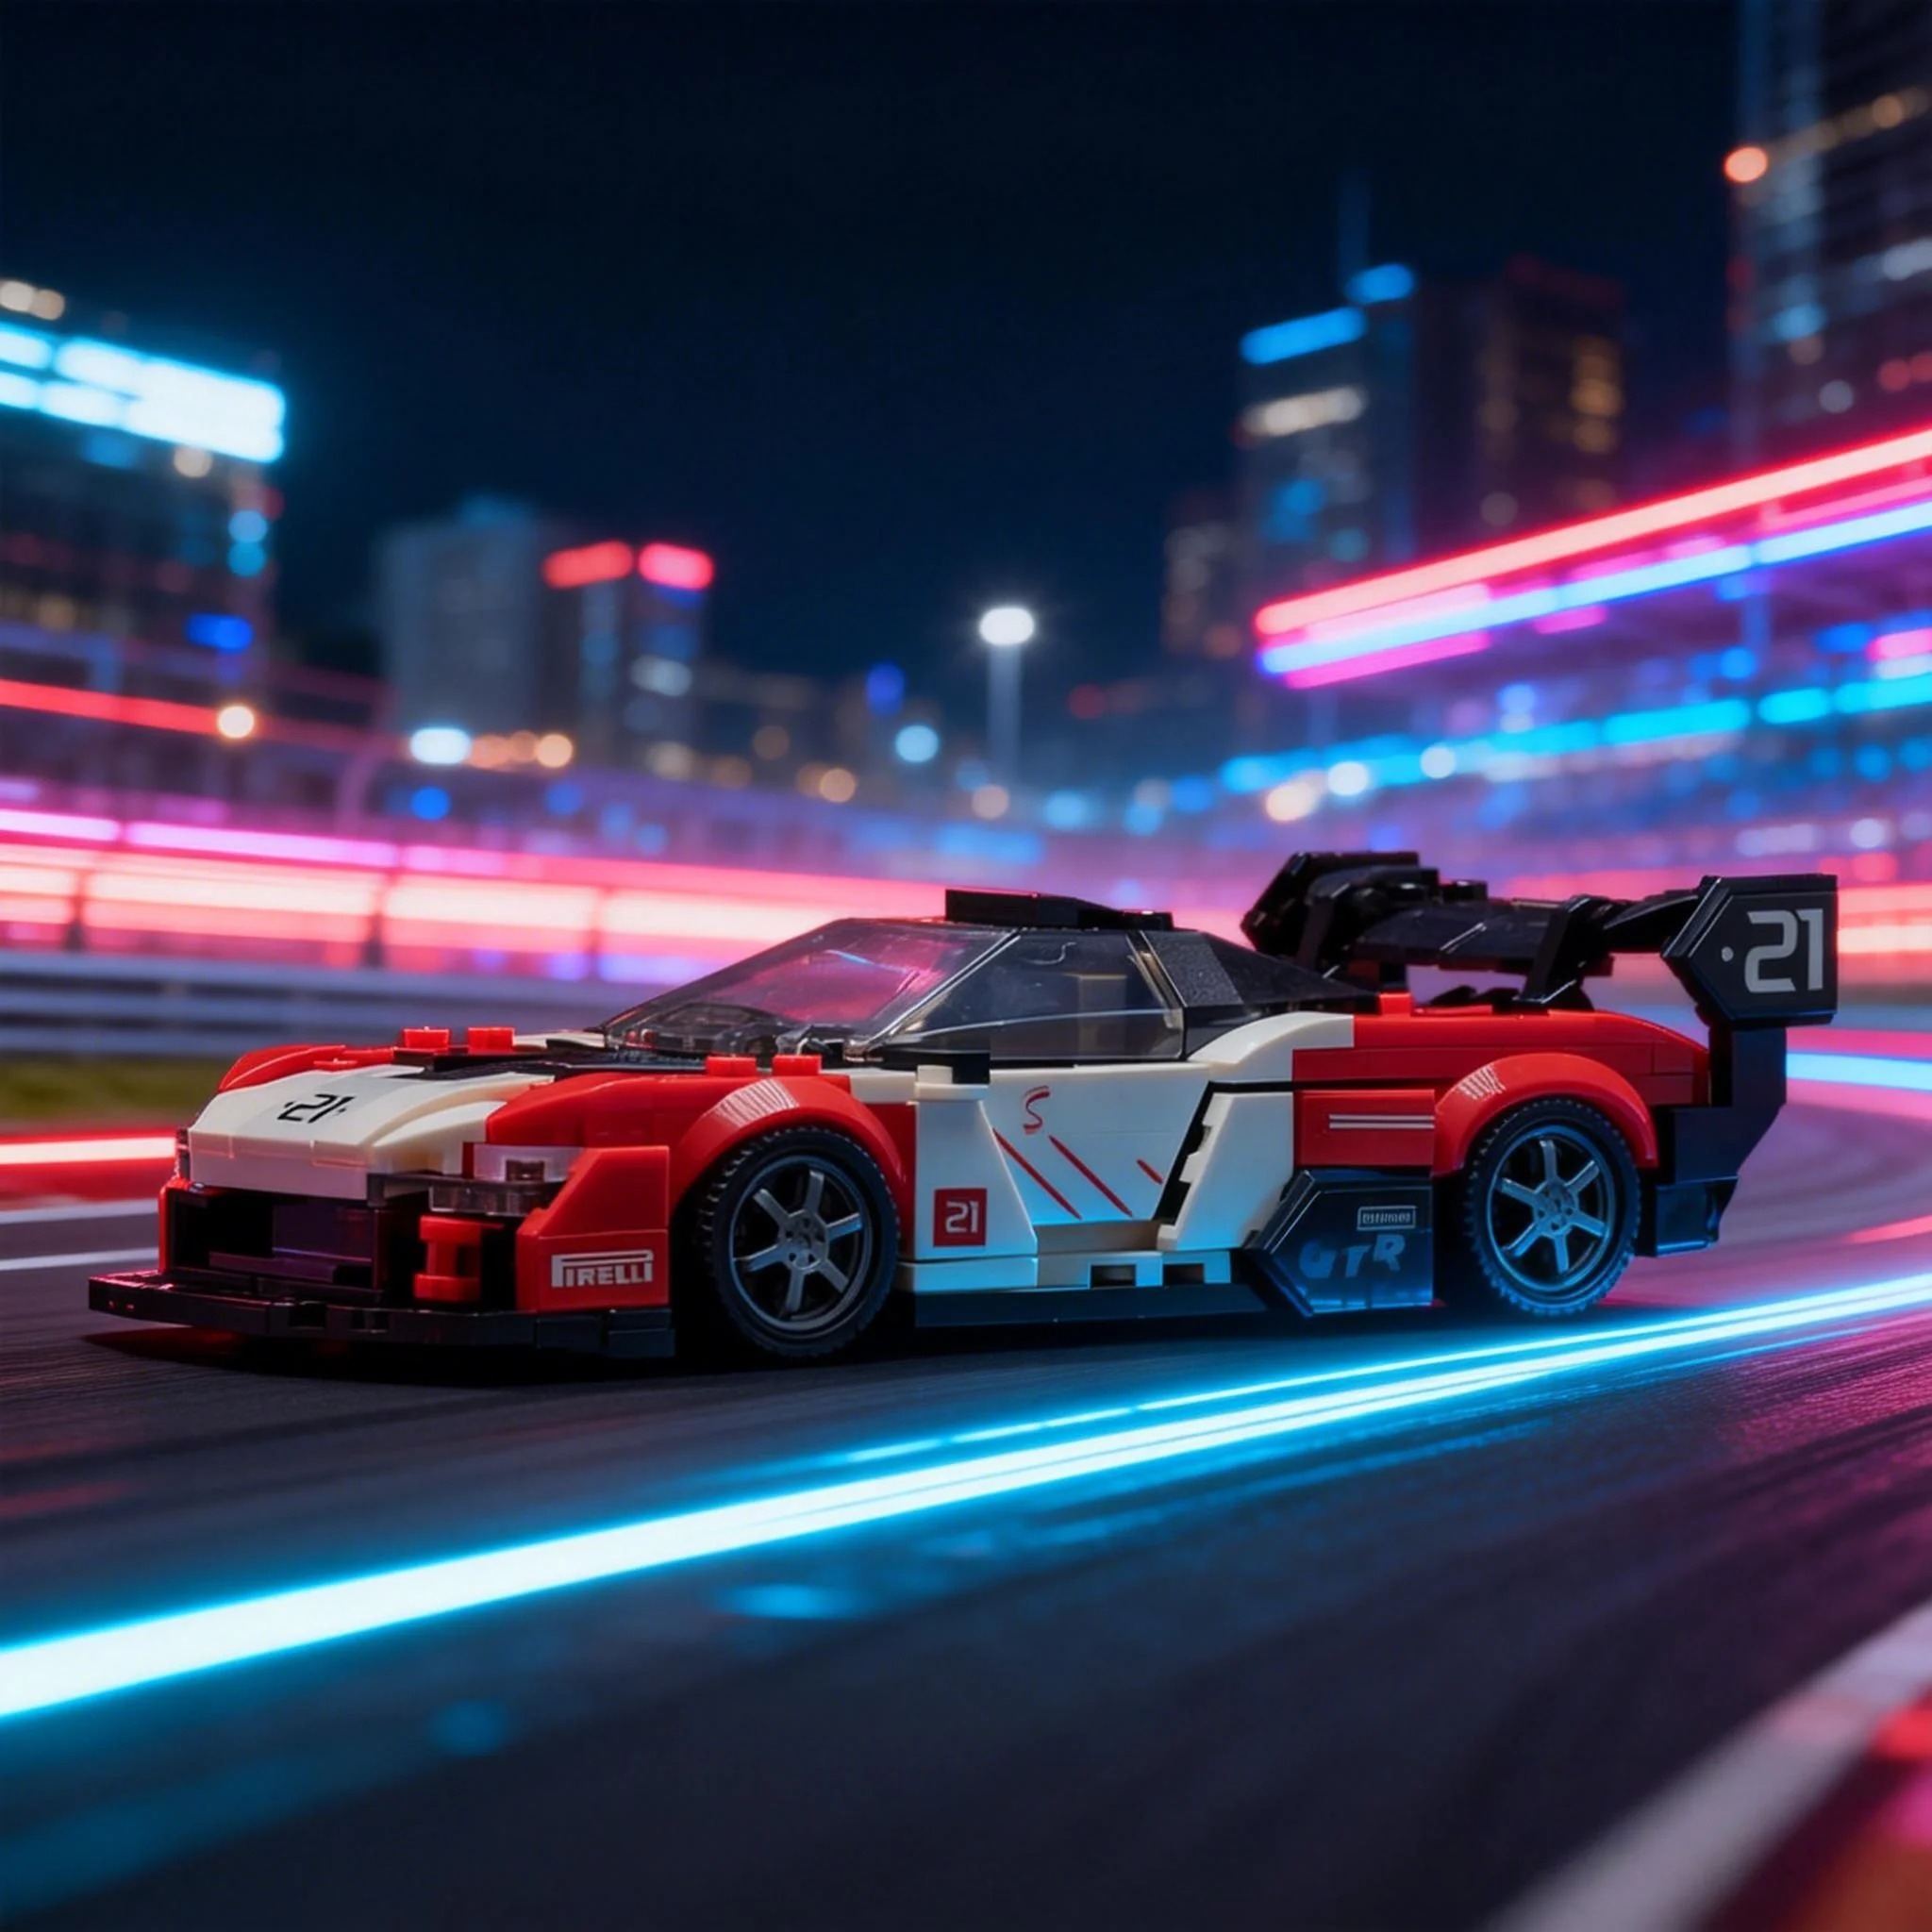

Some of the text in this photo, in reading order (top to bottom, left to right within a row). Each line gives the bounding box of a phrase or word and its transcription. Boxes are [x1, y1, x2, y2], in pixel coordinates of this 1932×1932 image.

[1744, 908, 1824, 993] 21
[945, 1201, 979, 1233] 21
[551, 1249, 654, 1288] PIRELLI
